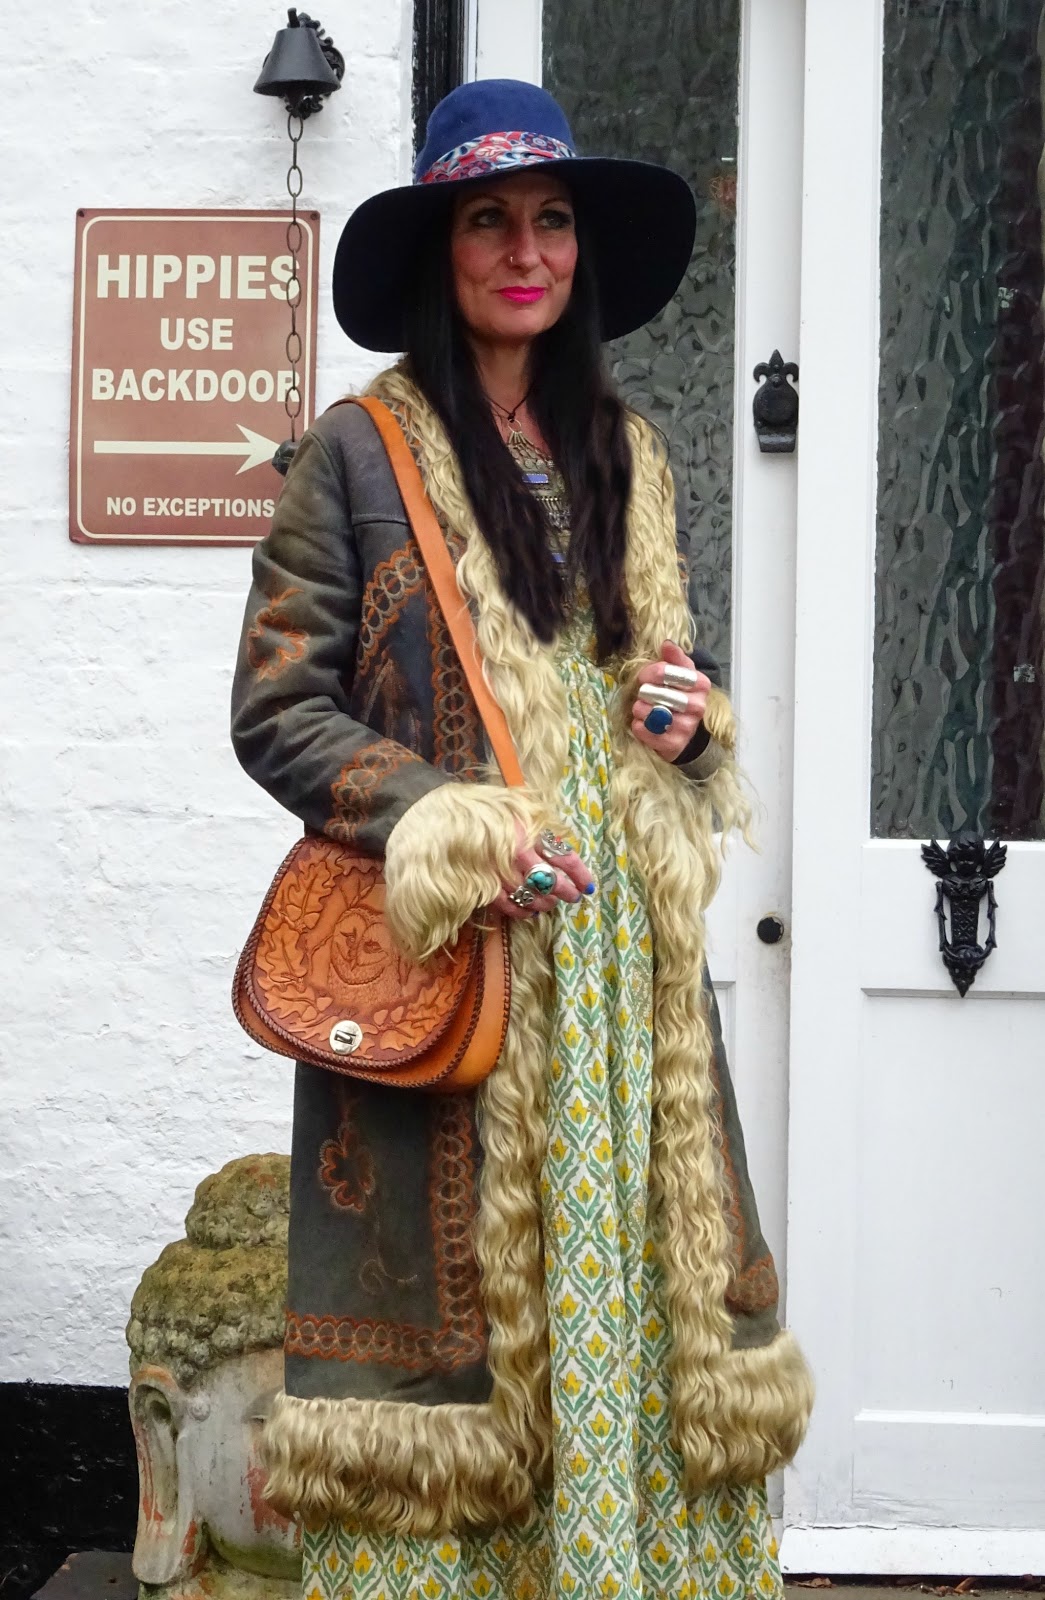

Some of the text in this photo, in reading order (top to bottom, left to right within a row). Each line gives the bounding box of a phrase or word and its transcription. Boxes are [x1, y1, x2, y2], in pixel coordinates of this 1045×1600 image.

[97, 254, 300, 300] HIPPIES
[160, 318, 233, 351] USE
[91, 368, 300, 403] BACKDOOR
[106, 496, 275, 518] NO EXCEPTIONS
